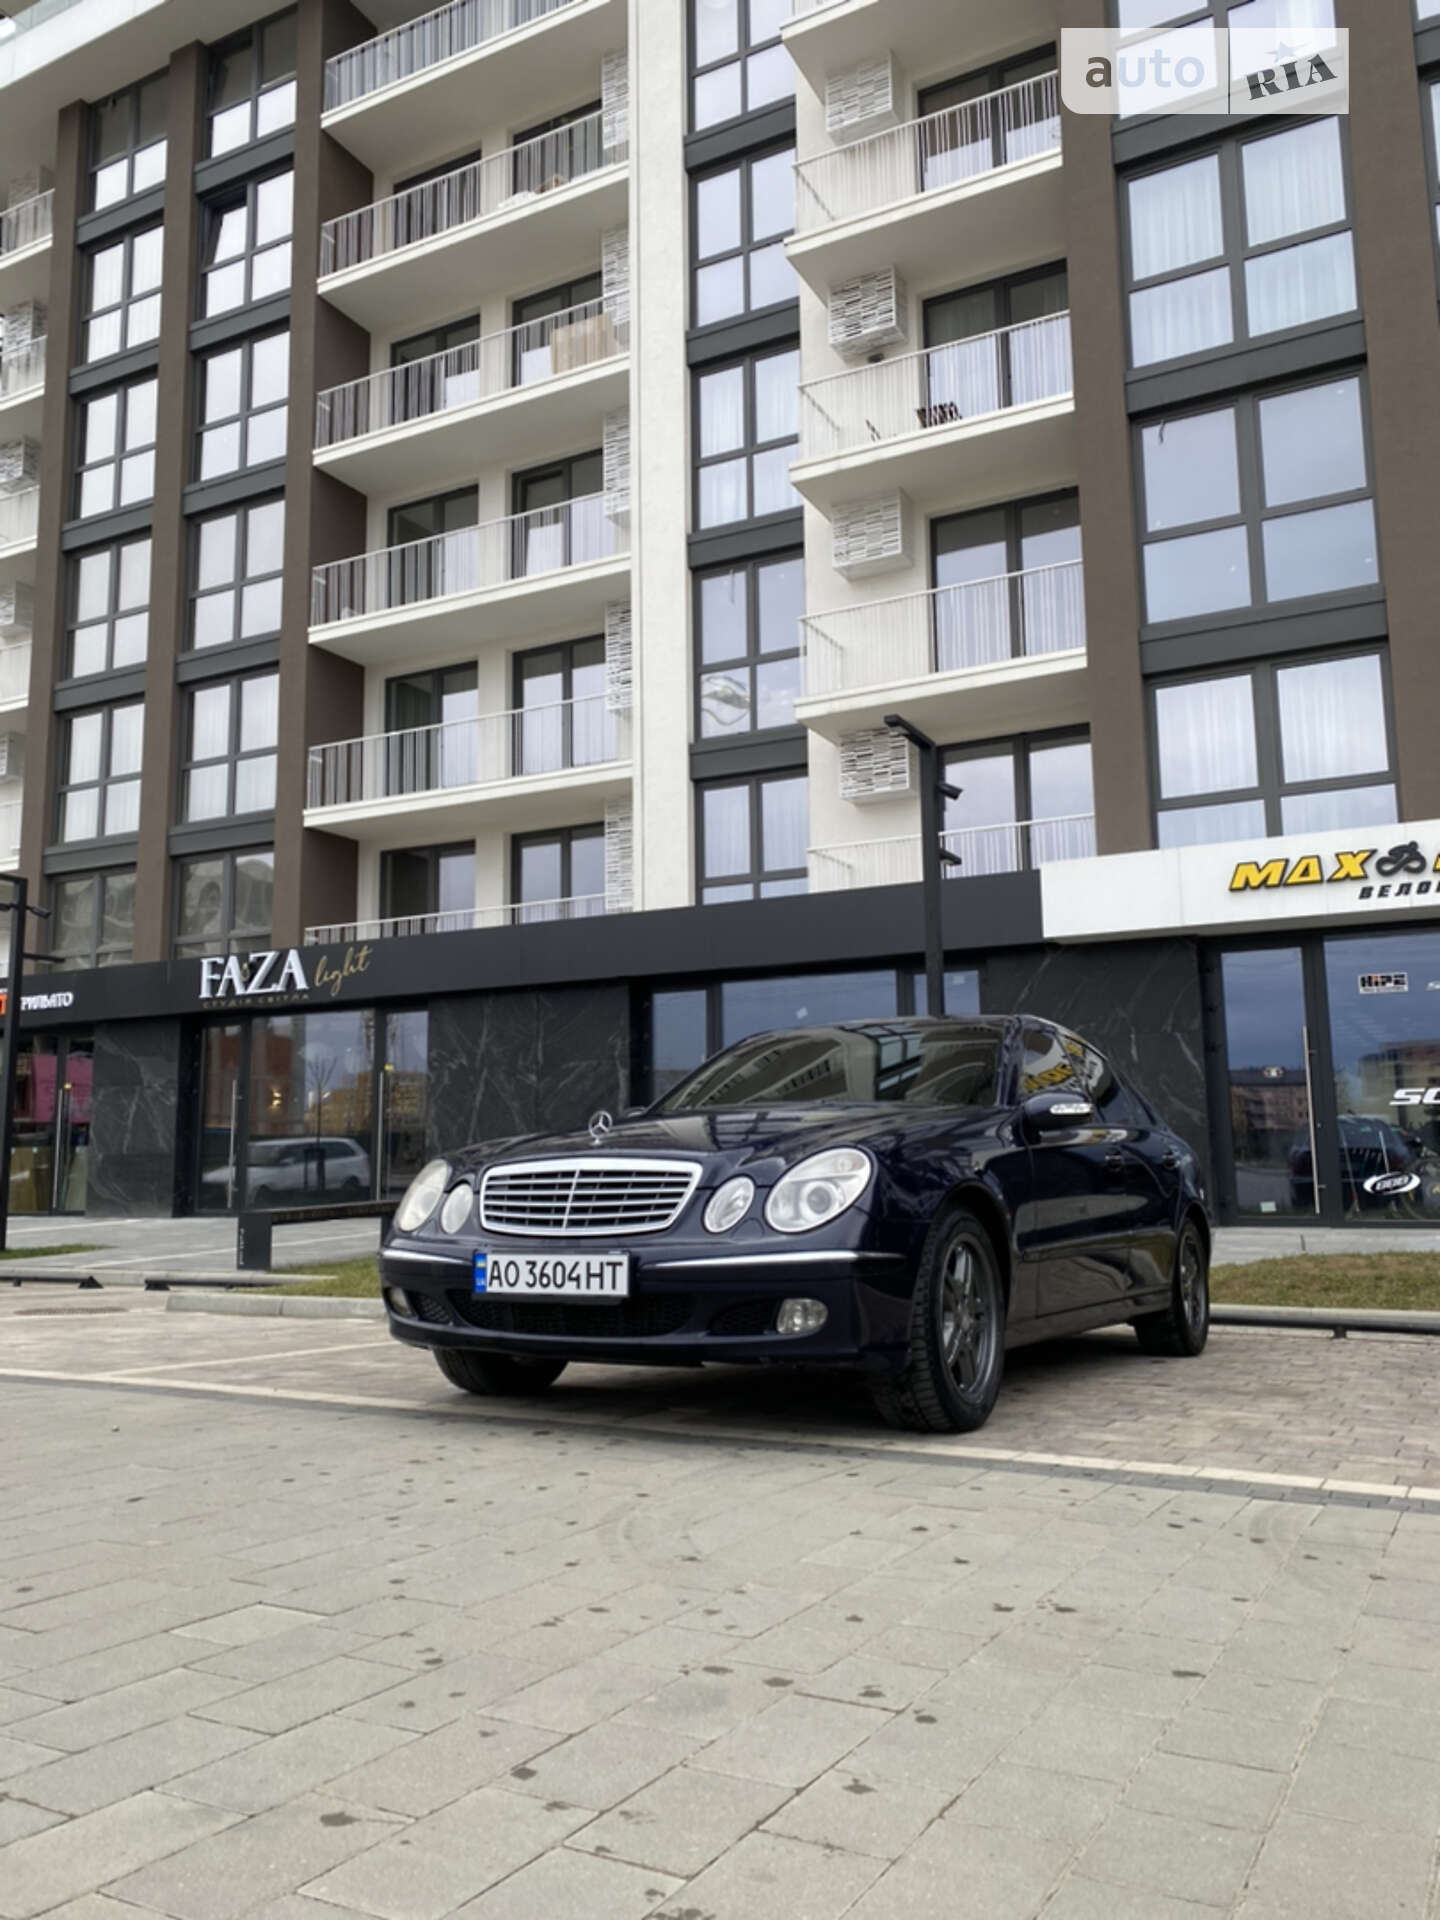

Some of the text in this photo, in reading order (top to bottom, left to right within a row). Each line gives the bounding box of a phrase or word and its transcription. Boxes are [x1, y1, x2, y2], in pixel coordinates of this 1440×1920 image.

[1229, 848, 1378, 892] MAX
[1358, 881, 1440, 900] ВЕЛО
[199, 945, 373, 999] FAZA light
[488, 1260, 623, 1290] AO 3604 HT
